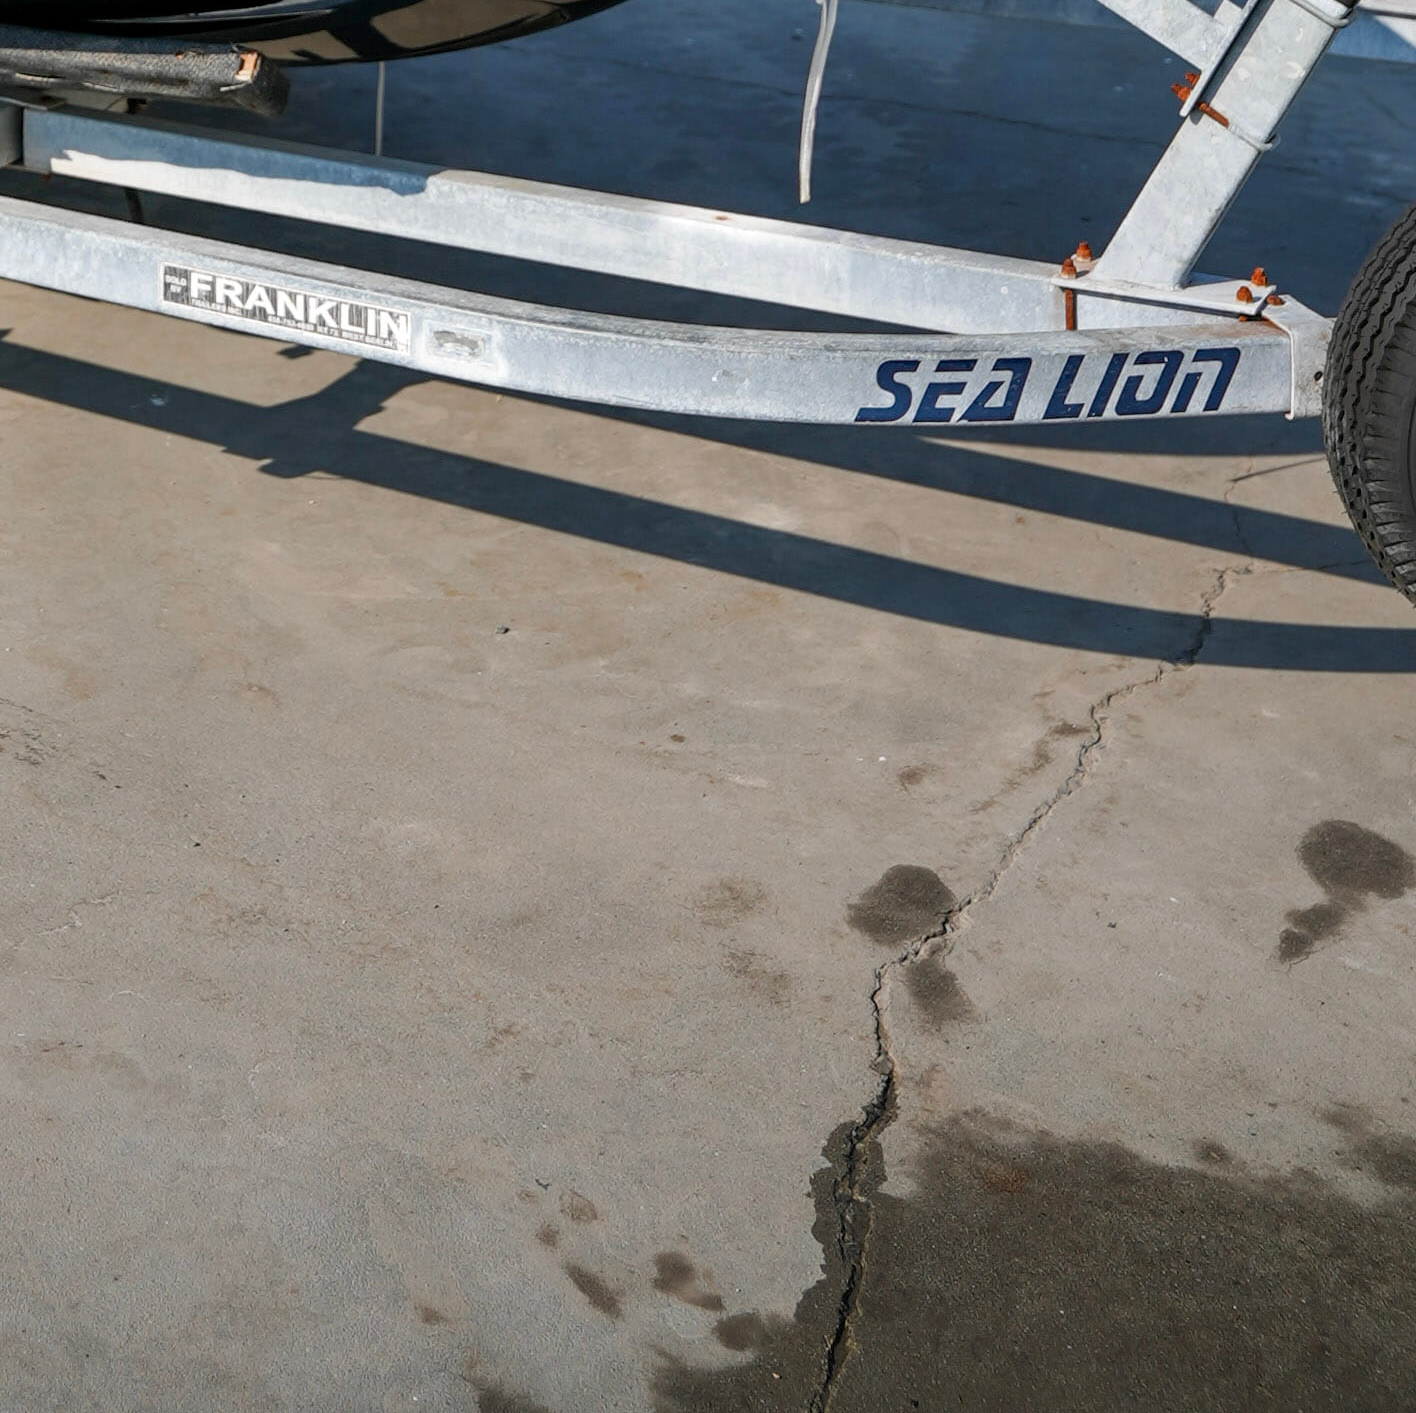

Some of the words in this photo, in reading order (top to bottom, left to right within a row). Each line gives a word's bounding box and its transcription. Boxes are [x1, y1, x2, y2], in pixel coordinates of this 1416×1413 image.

[165, 274, 186, 287] SOLD
[190, 272, 407, 343] FRANKLIN
[854, 356, 1033, 425] SEA
[1041, 346, 1241, 421] LION
